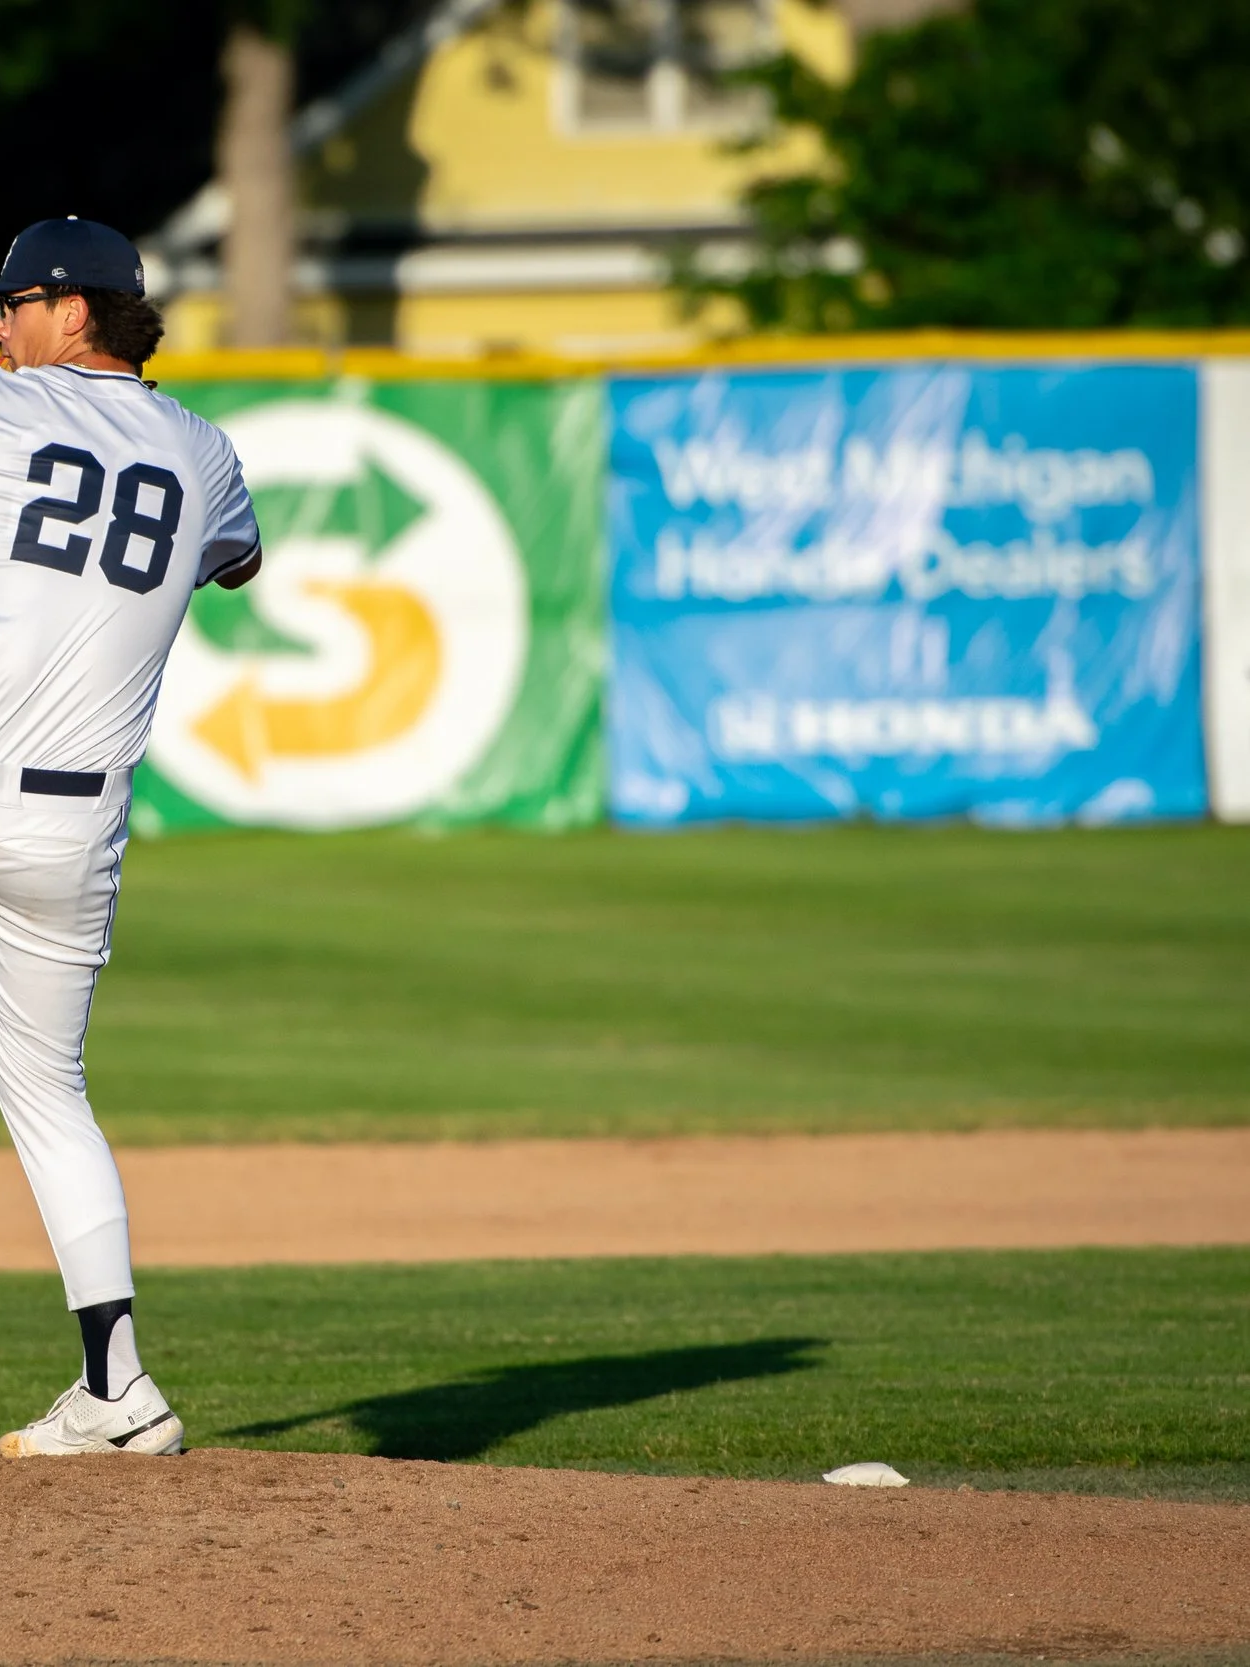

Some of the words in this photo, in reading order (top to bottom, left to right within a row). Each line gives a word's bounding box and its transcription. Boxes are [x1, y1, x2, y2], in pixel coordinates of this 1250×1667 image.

[654, 438, 830, 507] West
[843, 430, 1156, 520] Michigan
[10, 442, 185, 596] 28
[655, 525, 892, 600] Honda
[897, 525, 1154, 600] Dealers
[791, 695, 1100, 758] HONDA
